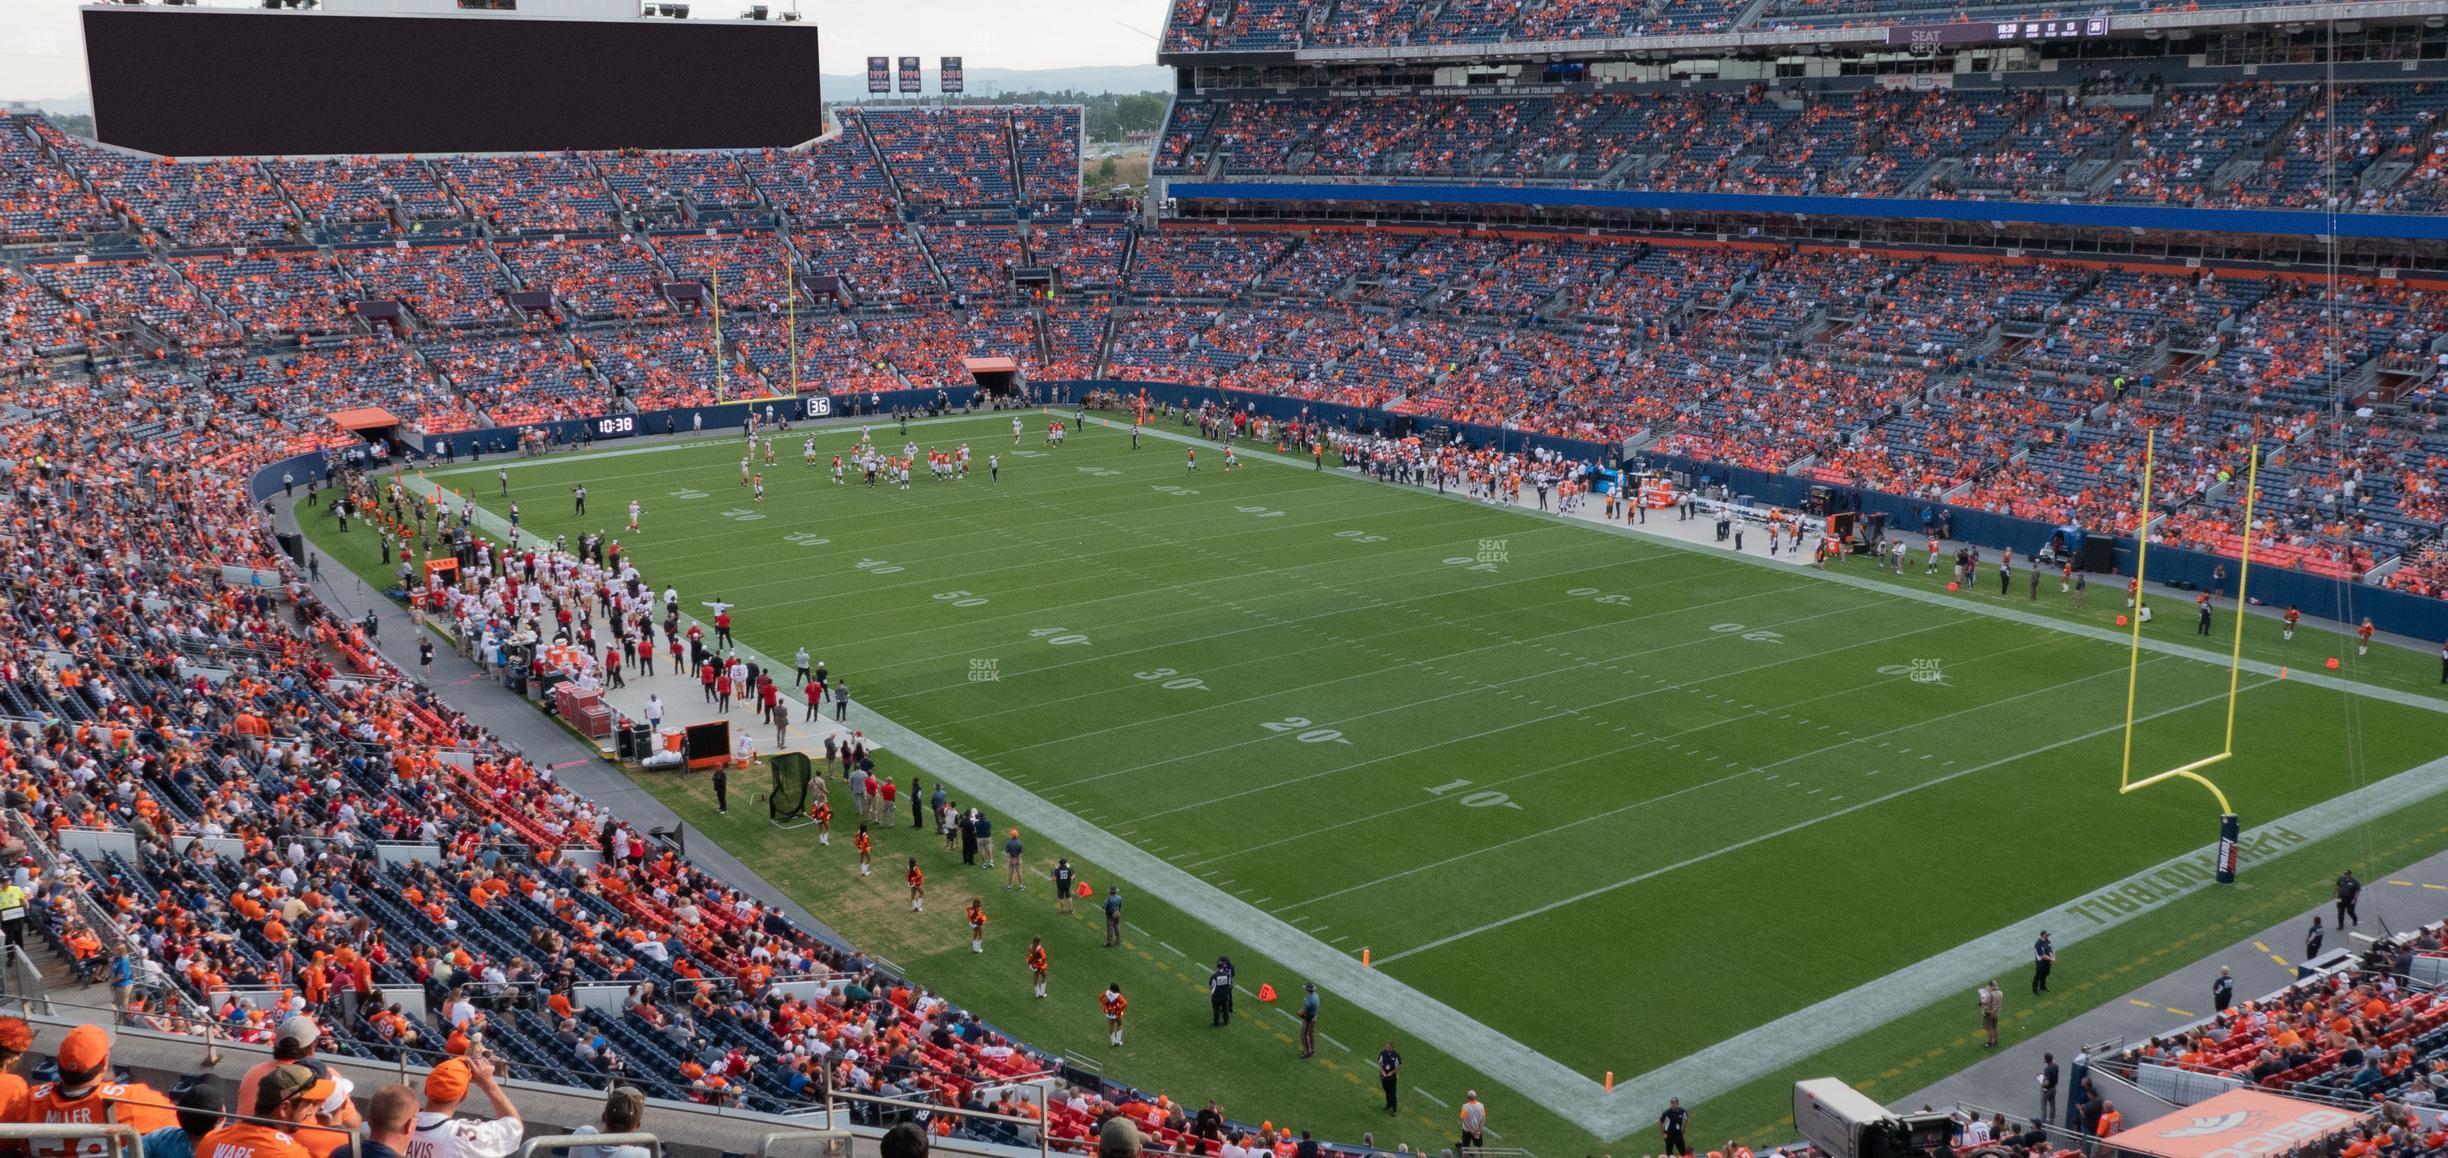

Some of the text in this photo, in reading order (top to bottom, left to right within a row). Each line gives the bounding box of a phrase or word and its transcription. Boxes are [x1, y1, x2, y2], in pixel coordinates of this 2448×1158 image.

[2382, 269, 2395, 277] 107
[811, 400, 828, 413] 36
[599, 417, 633, 434] 10:38
[417, 597, 426, 606] G
[931, 590, 990, 607] 50
[1028, 627, 1090, 645] 40
[1133, 668, 1205, 690] 30
[1259, 716, 1345, 744] 20
[1423, 778, 1512, 808] 10
[1261, 986, 1268, 999] G
[377, 1018, 394, 1037] 58
[1977, 1130, 1988, 1142] 18
[406, 1140, 434, 1158] AVIS
